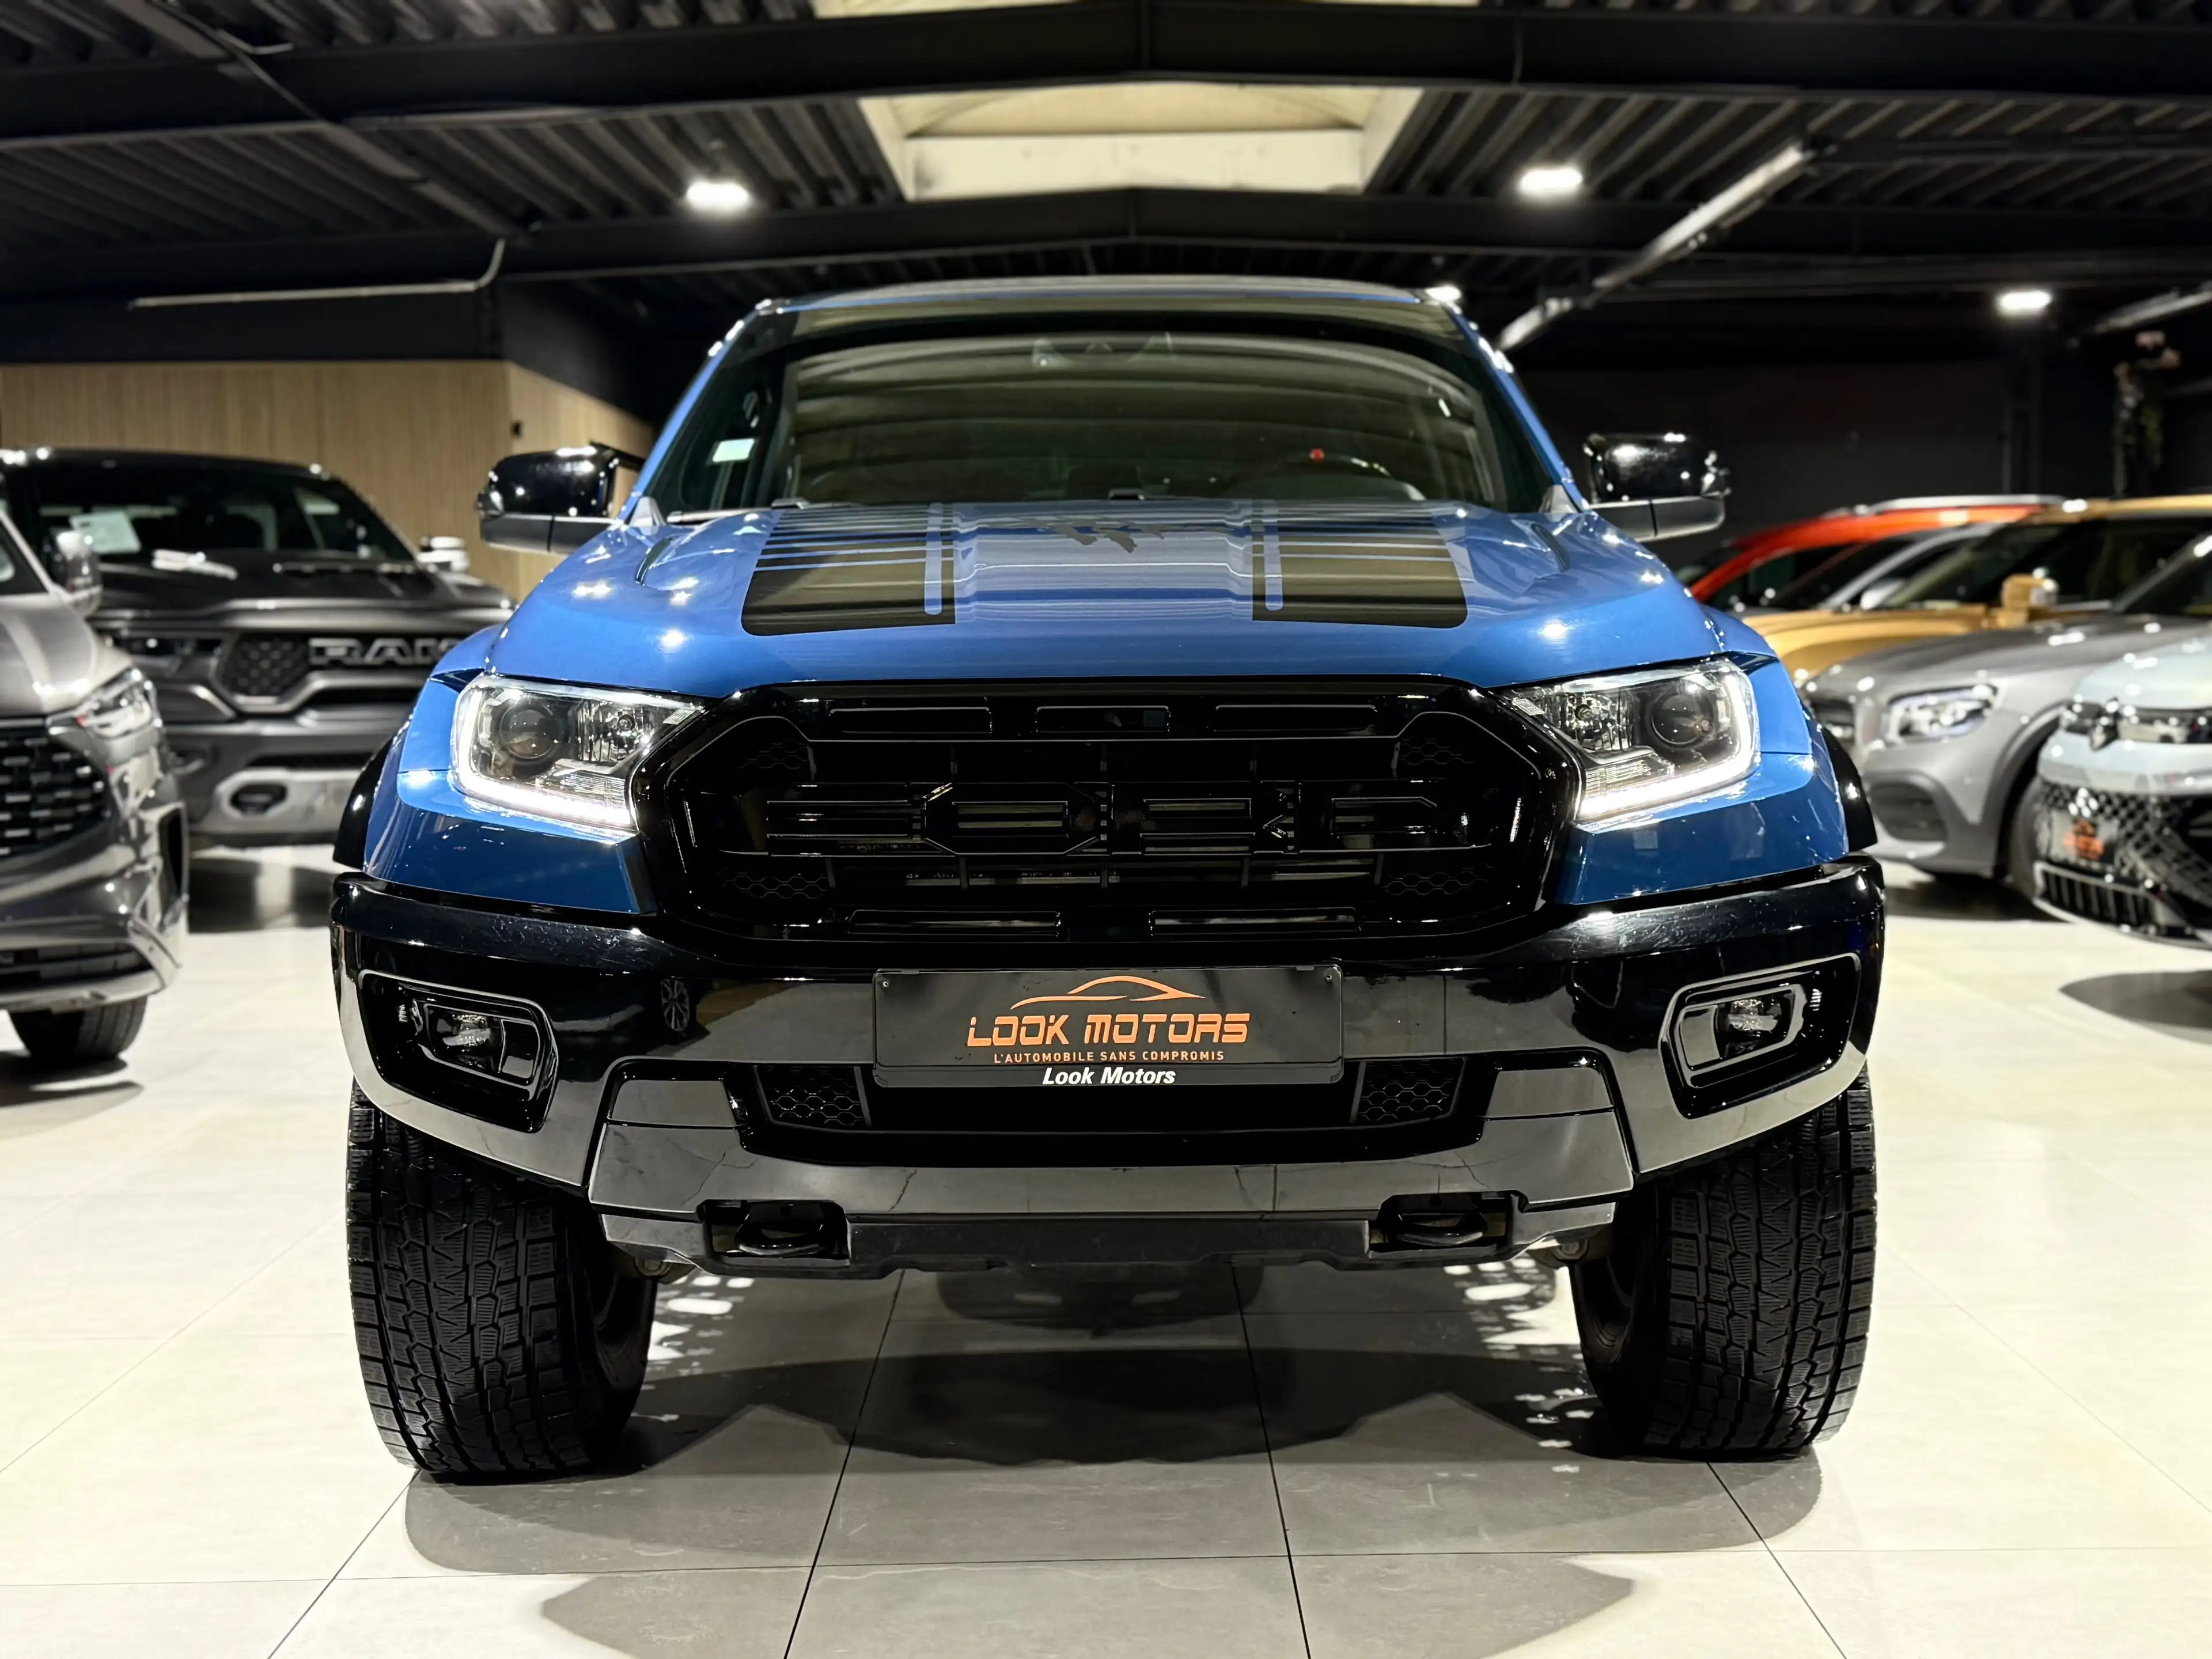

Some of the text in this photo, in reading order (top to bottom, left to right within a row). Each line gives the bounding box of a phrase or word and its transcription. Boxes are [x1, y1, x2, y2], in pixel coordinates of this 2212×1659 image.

[967, 1013, 1251, 1047] LOOK MOTORS
[994, 1051, 1224, 1063] L'AUTOMOBILE SANS COMPROMIS
[1042, 1066, 1176, 1085] Look Motors
